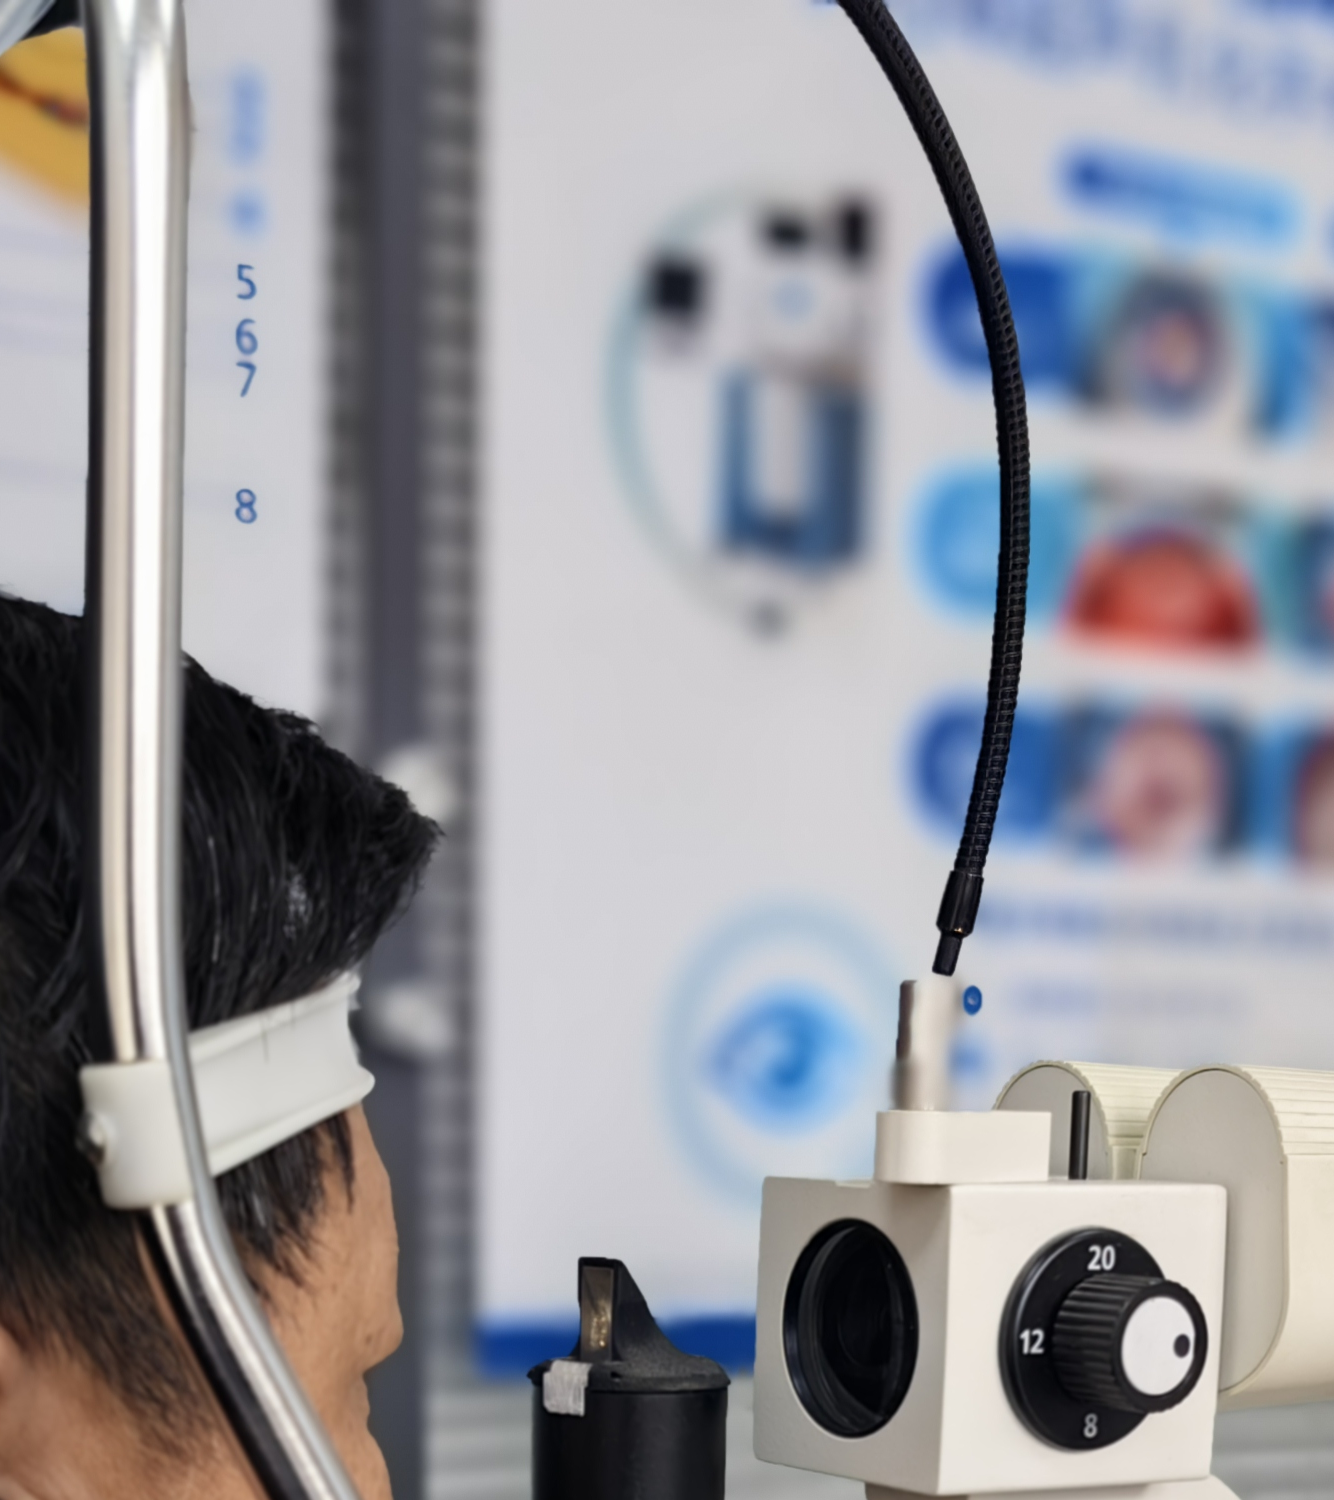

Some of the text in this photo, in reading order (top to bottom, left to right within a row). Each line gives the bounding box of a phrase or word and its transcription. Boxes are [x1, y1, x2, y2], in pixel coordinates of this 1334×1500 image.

[236, 263, 257, 300] 5
[235, 318, 258, 355] 6
[236, 361, 257, 397] 7
[235, 488, 258, 524] 8
[1087, 1245, 1116, 1271] 20
[1019, 1329, 1045, 1355] 12
[1083, 1413, 1098, 1438] 8
